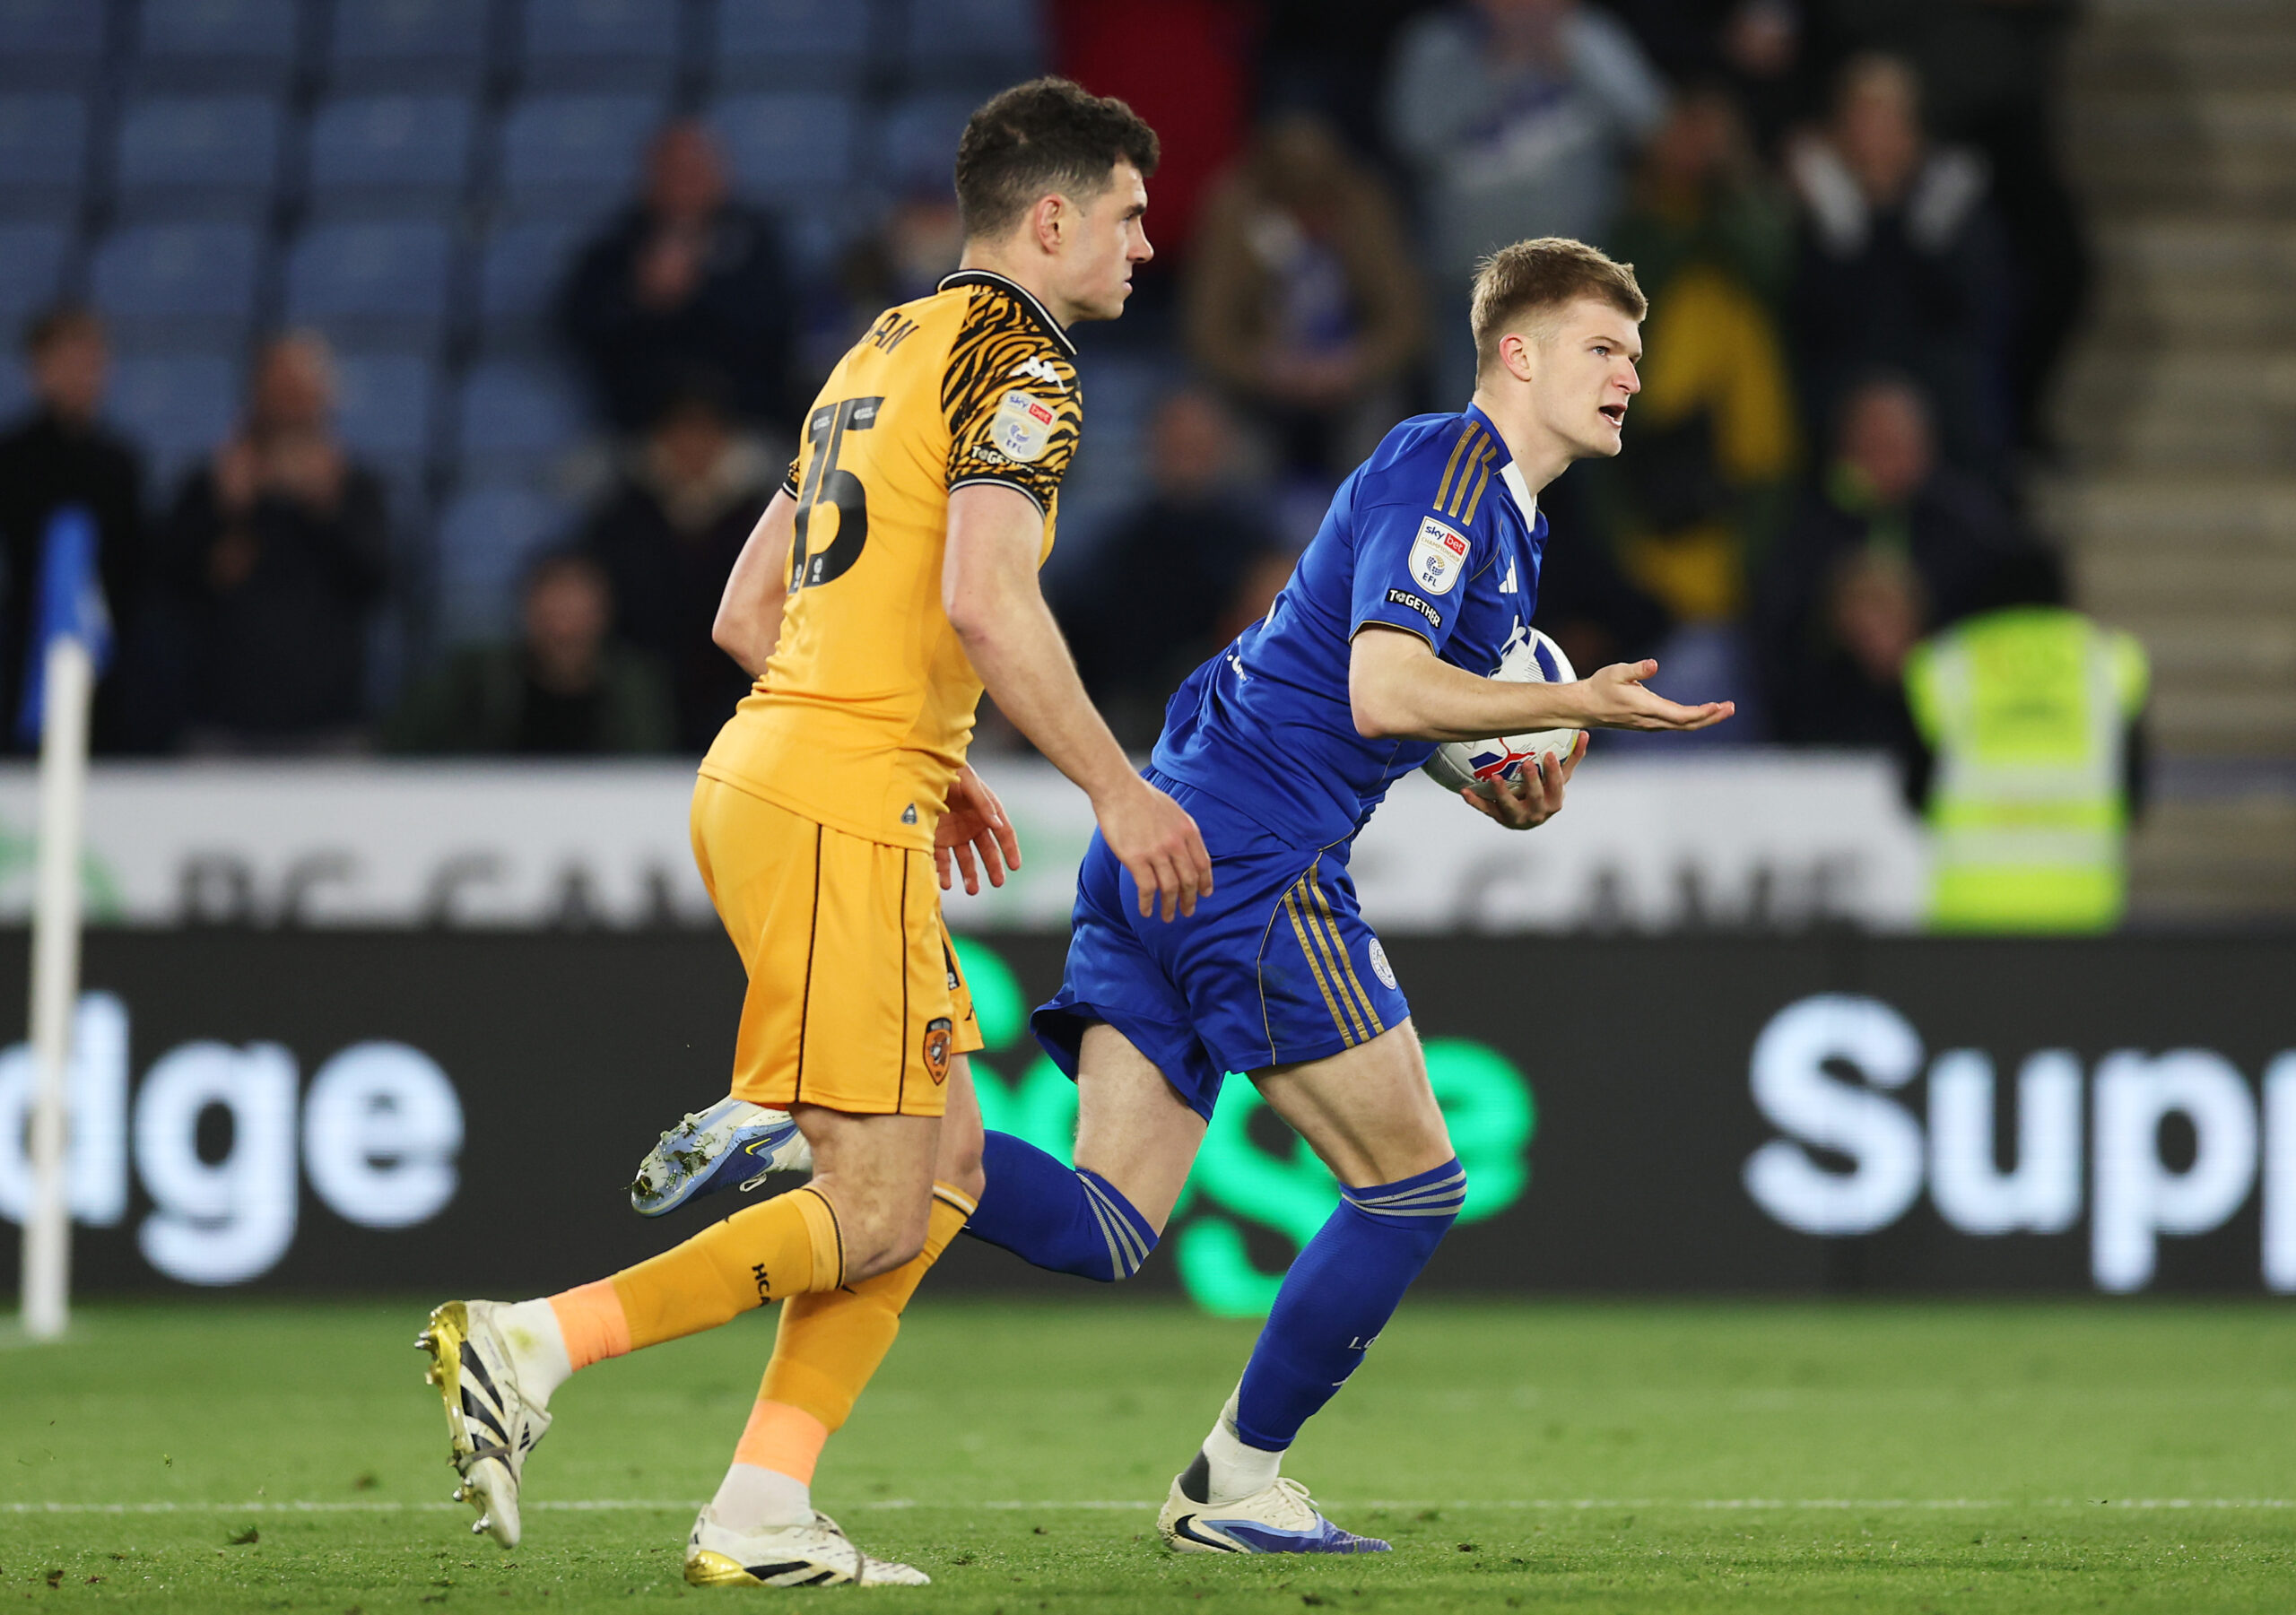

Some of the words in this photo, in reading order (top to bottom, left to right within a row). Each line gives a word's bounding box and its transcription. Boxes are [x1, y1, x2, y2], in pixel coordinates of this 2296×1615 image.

[789, 396, 885, 594] 15
[1421, 536, 1460, 562] CHAMPIONSHIP
[1425, 525, 1445, 540] sky
[1446, 535, 1464, 552] bet
[1422, 572, 1437, 587] EFL
[1389, 589, 1441, 628] TOGETHER
[1744, 991, 2296, 1294] Sup
